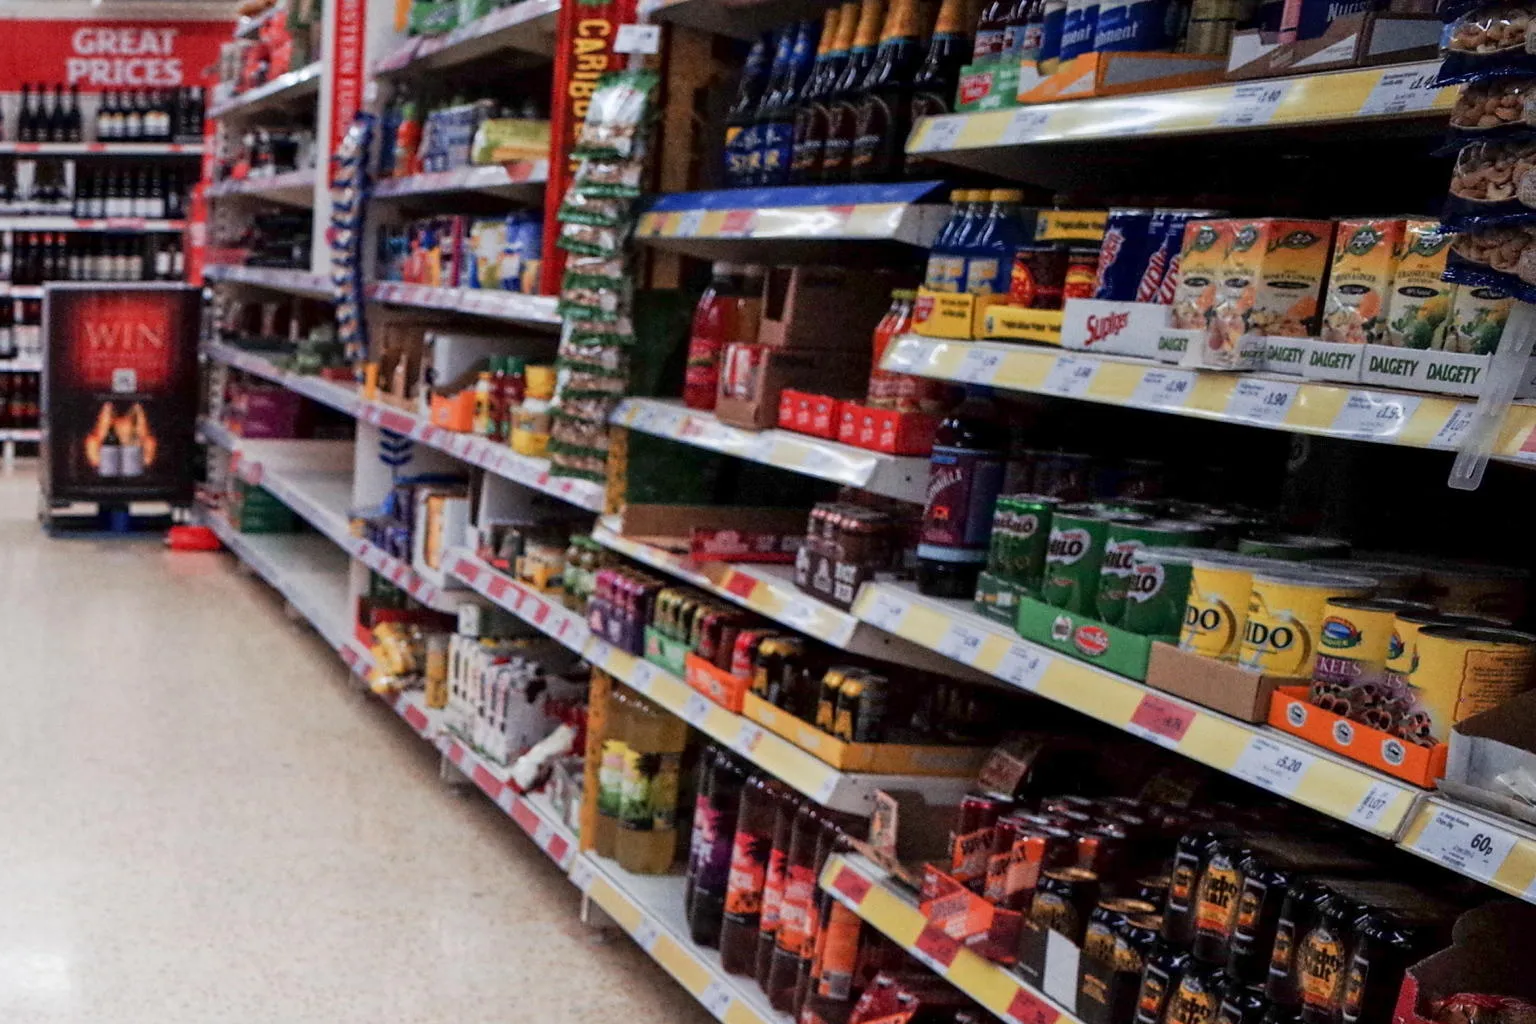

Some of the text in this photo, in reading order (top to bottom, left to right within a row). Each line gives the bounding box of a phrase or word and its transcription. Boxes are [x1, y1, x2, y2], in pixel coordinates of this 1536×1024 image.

[73, 27, 178, 56] GREAT
[67, 58, 183, 86] PRICES
[84, 322, 163, 349] WIN
[1309, 350, 1355, 370] DALGETY
[1369, 355, 1481, 384] DALGETY DALGETY
[1470, 833, 1493, 856] 60p
